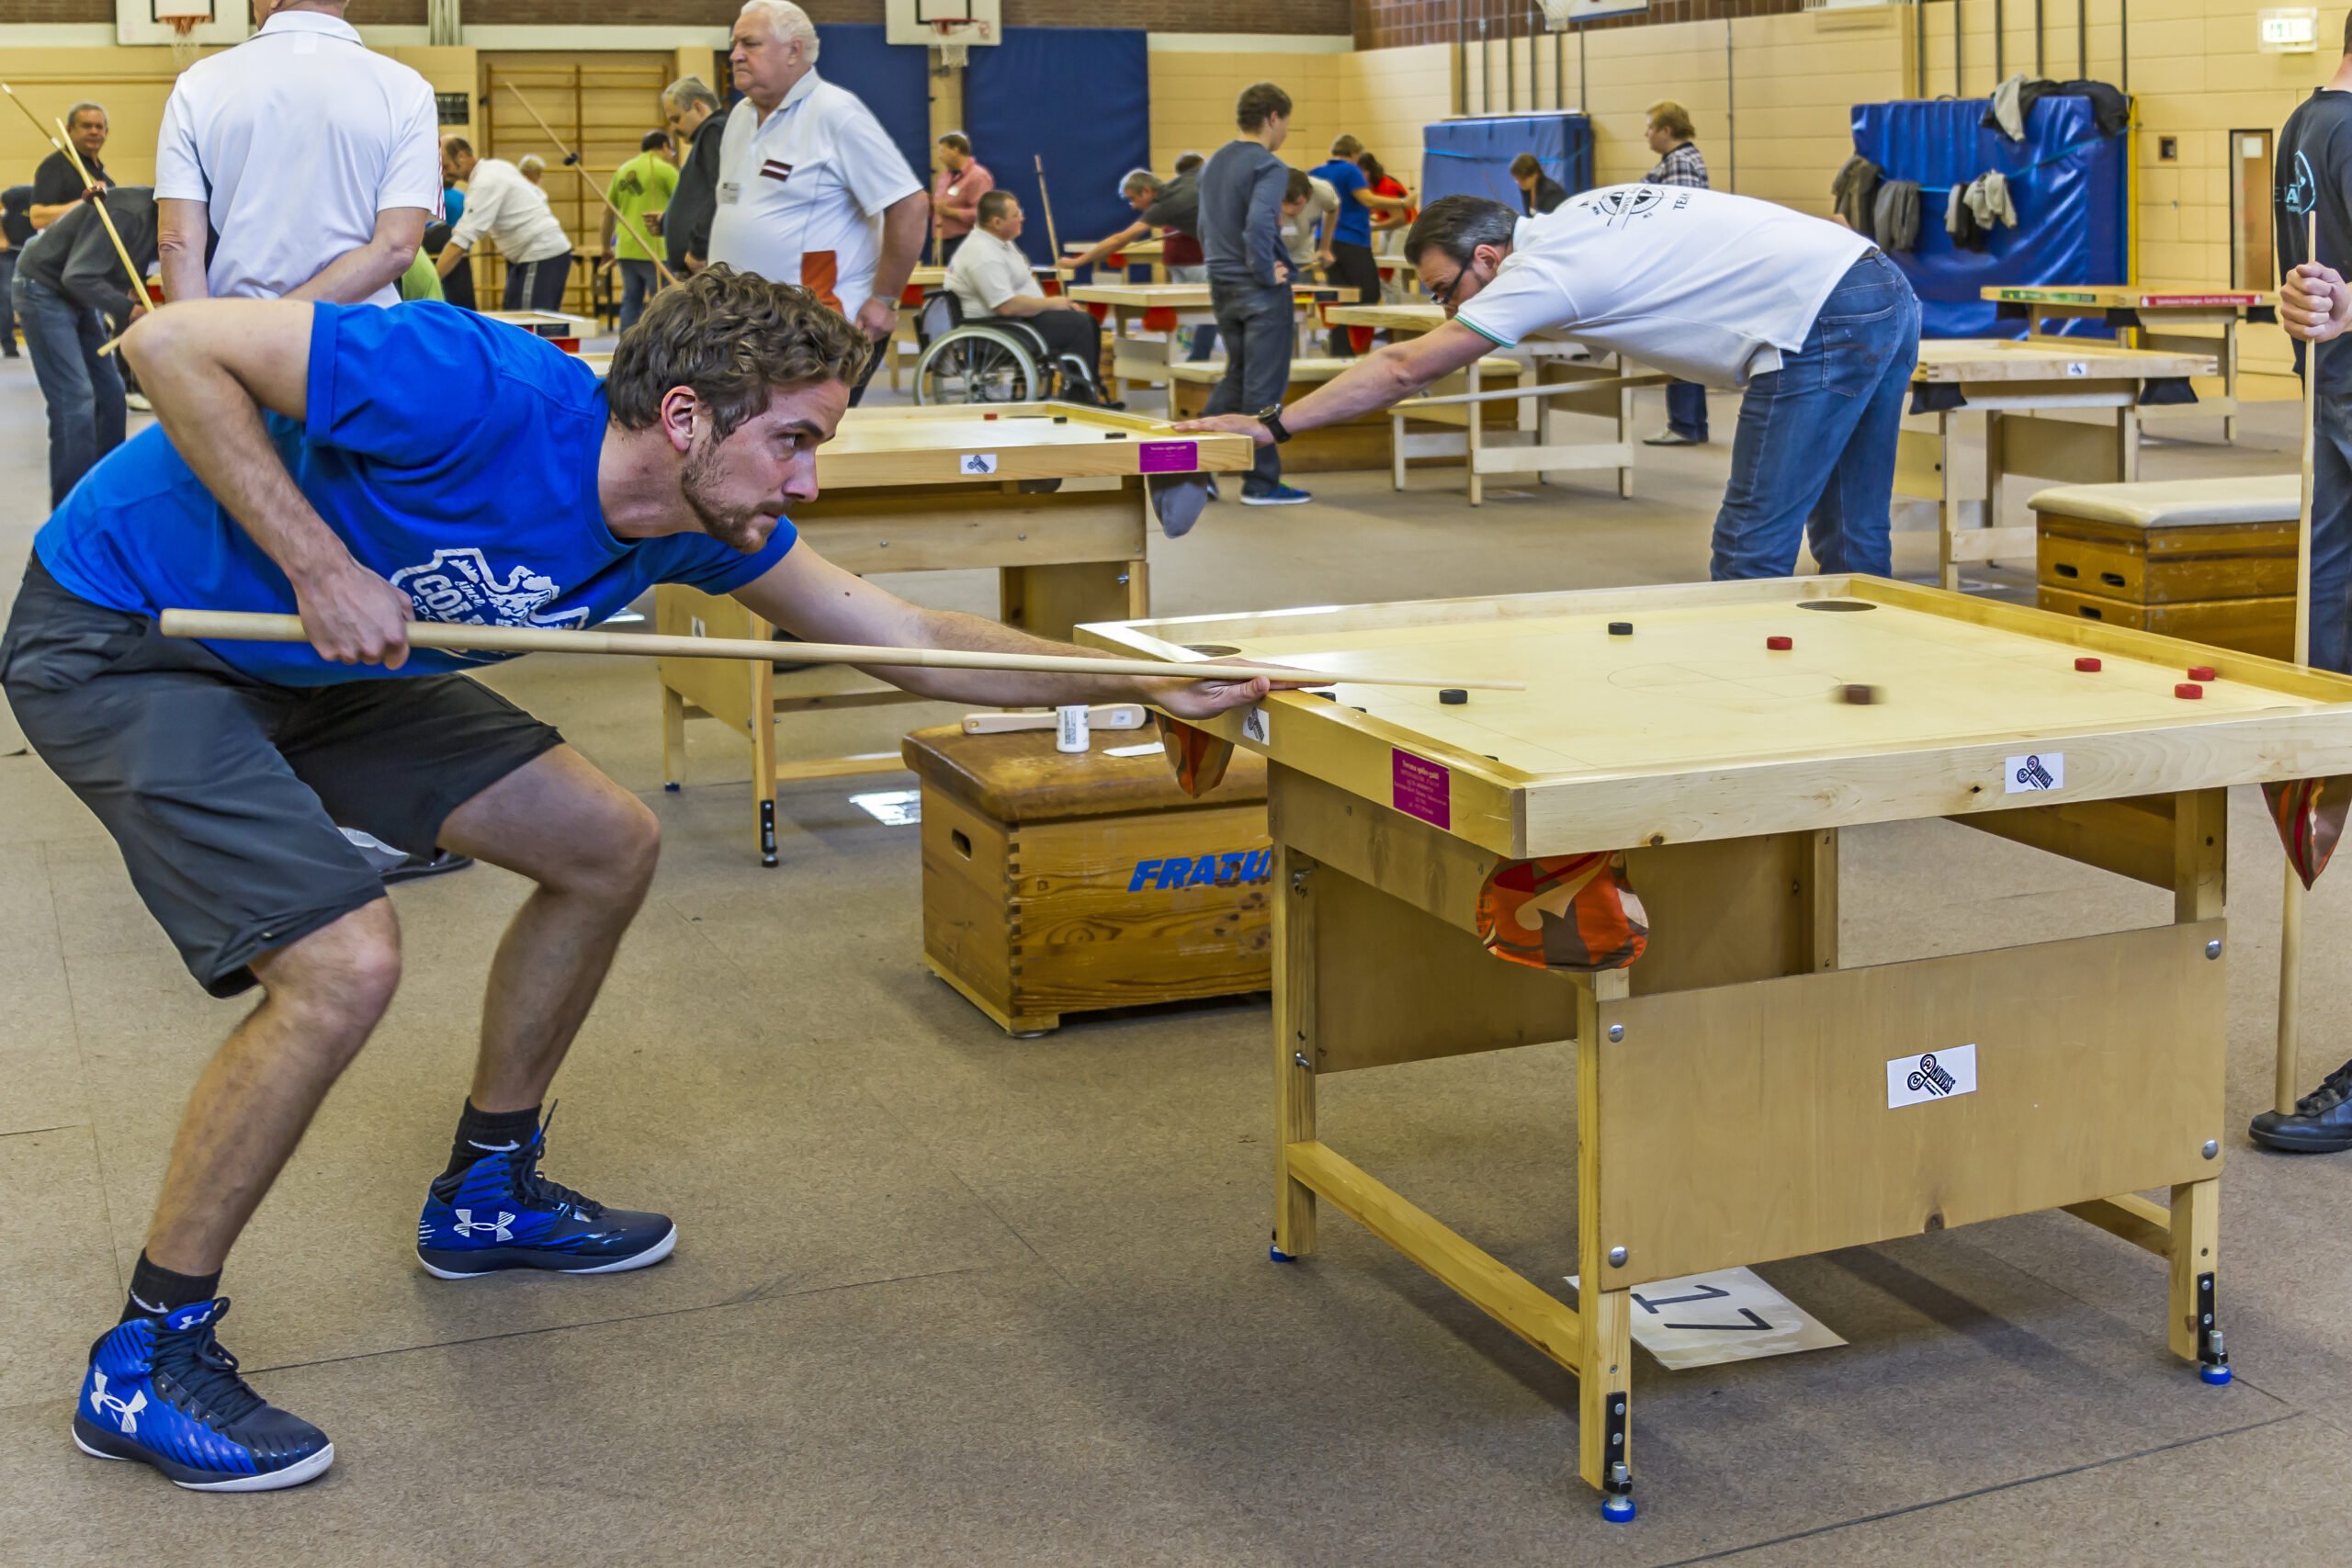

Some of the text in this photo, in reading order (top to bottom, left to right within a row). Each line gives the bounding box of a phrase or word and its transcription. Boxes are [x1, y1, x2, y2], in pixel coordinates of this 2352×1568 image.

[455, 581, 486, 607] since
[1127, 849, 1272, 892] FRATU
[1930, 1065, 1956, 1093] NOVUSS
[1630, 1284, 1774, 1331] 17
